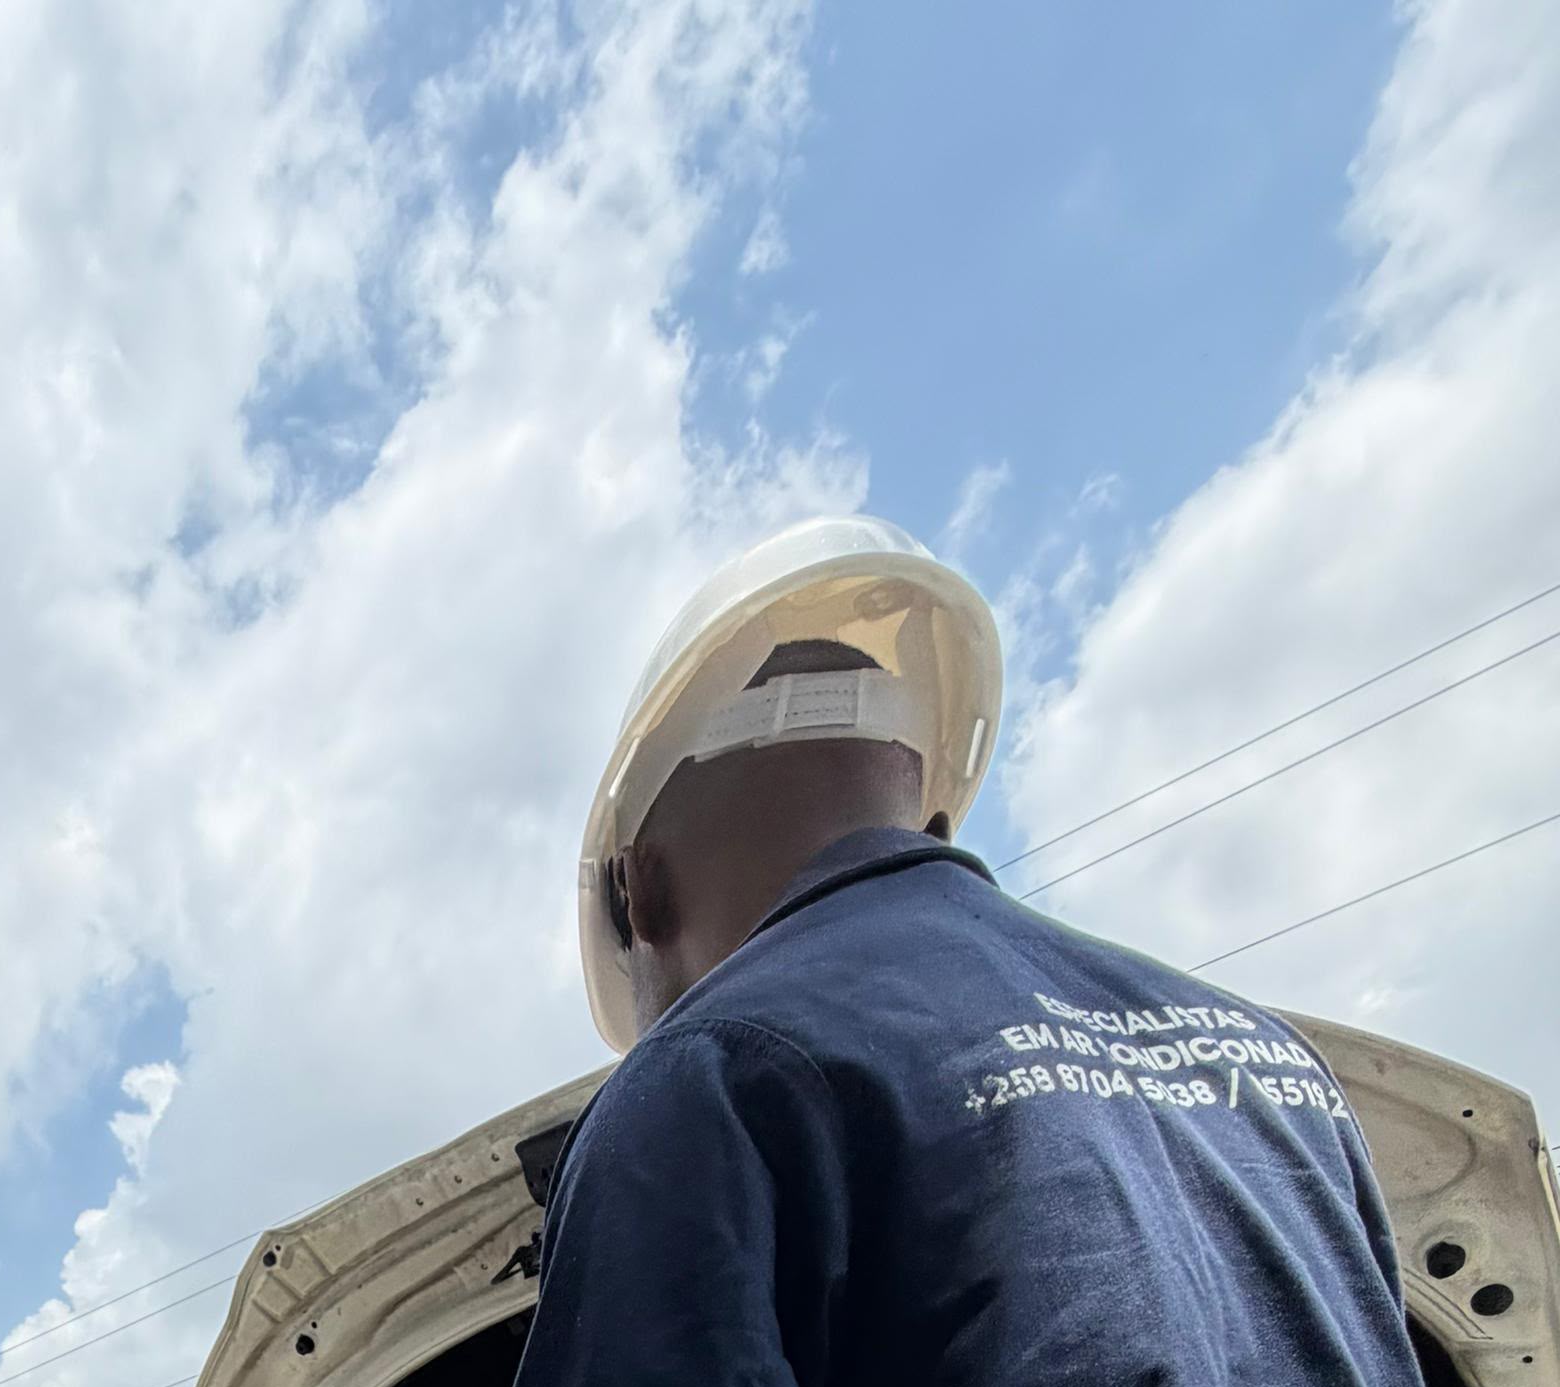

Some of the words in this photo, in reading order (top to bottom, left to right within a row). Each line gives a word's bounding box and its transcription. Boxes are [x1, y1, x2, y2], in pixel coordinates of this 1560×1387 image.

[1000, 1023, 1059, 1051] EM
[1059, 1026, 1100, 1056] AR
[965, 1065, 1055, 1114] +258
